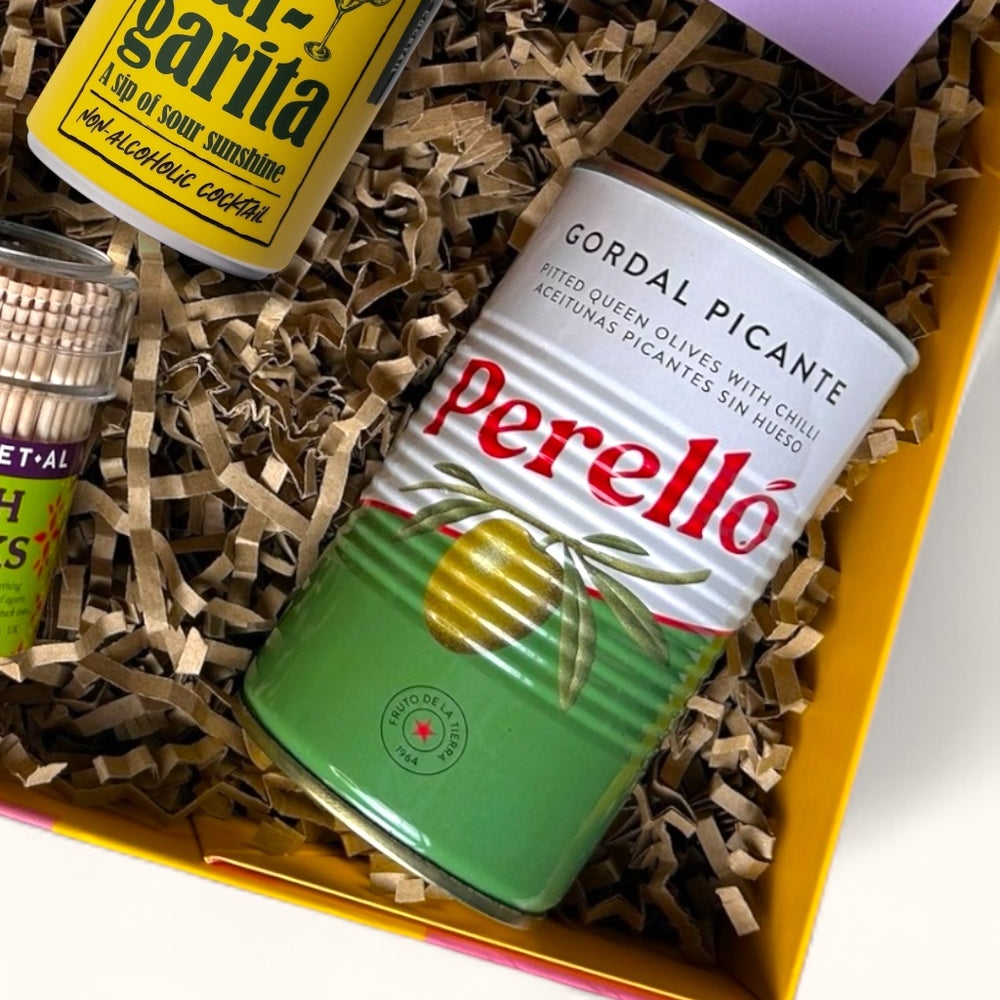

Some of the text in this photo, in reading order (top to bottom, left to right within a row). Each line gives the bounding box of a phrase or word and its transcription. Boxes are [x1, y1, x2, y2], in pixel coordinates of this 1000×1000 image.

[98, 61, 286, 184] A sip of sour sunshine
[533, 282, 803, 455] ACEITUNAS PICANTES SIN HUESO
[539, 262, 821, 442] PITTED QUEEN OLIVES WITH CHILLI
[564, 222, 849, 407] GORDAL PICANTE
[388, 693, 460, 761] FRUTO DE LA TIERRA
[395, 745, 419, 766] 1964
